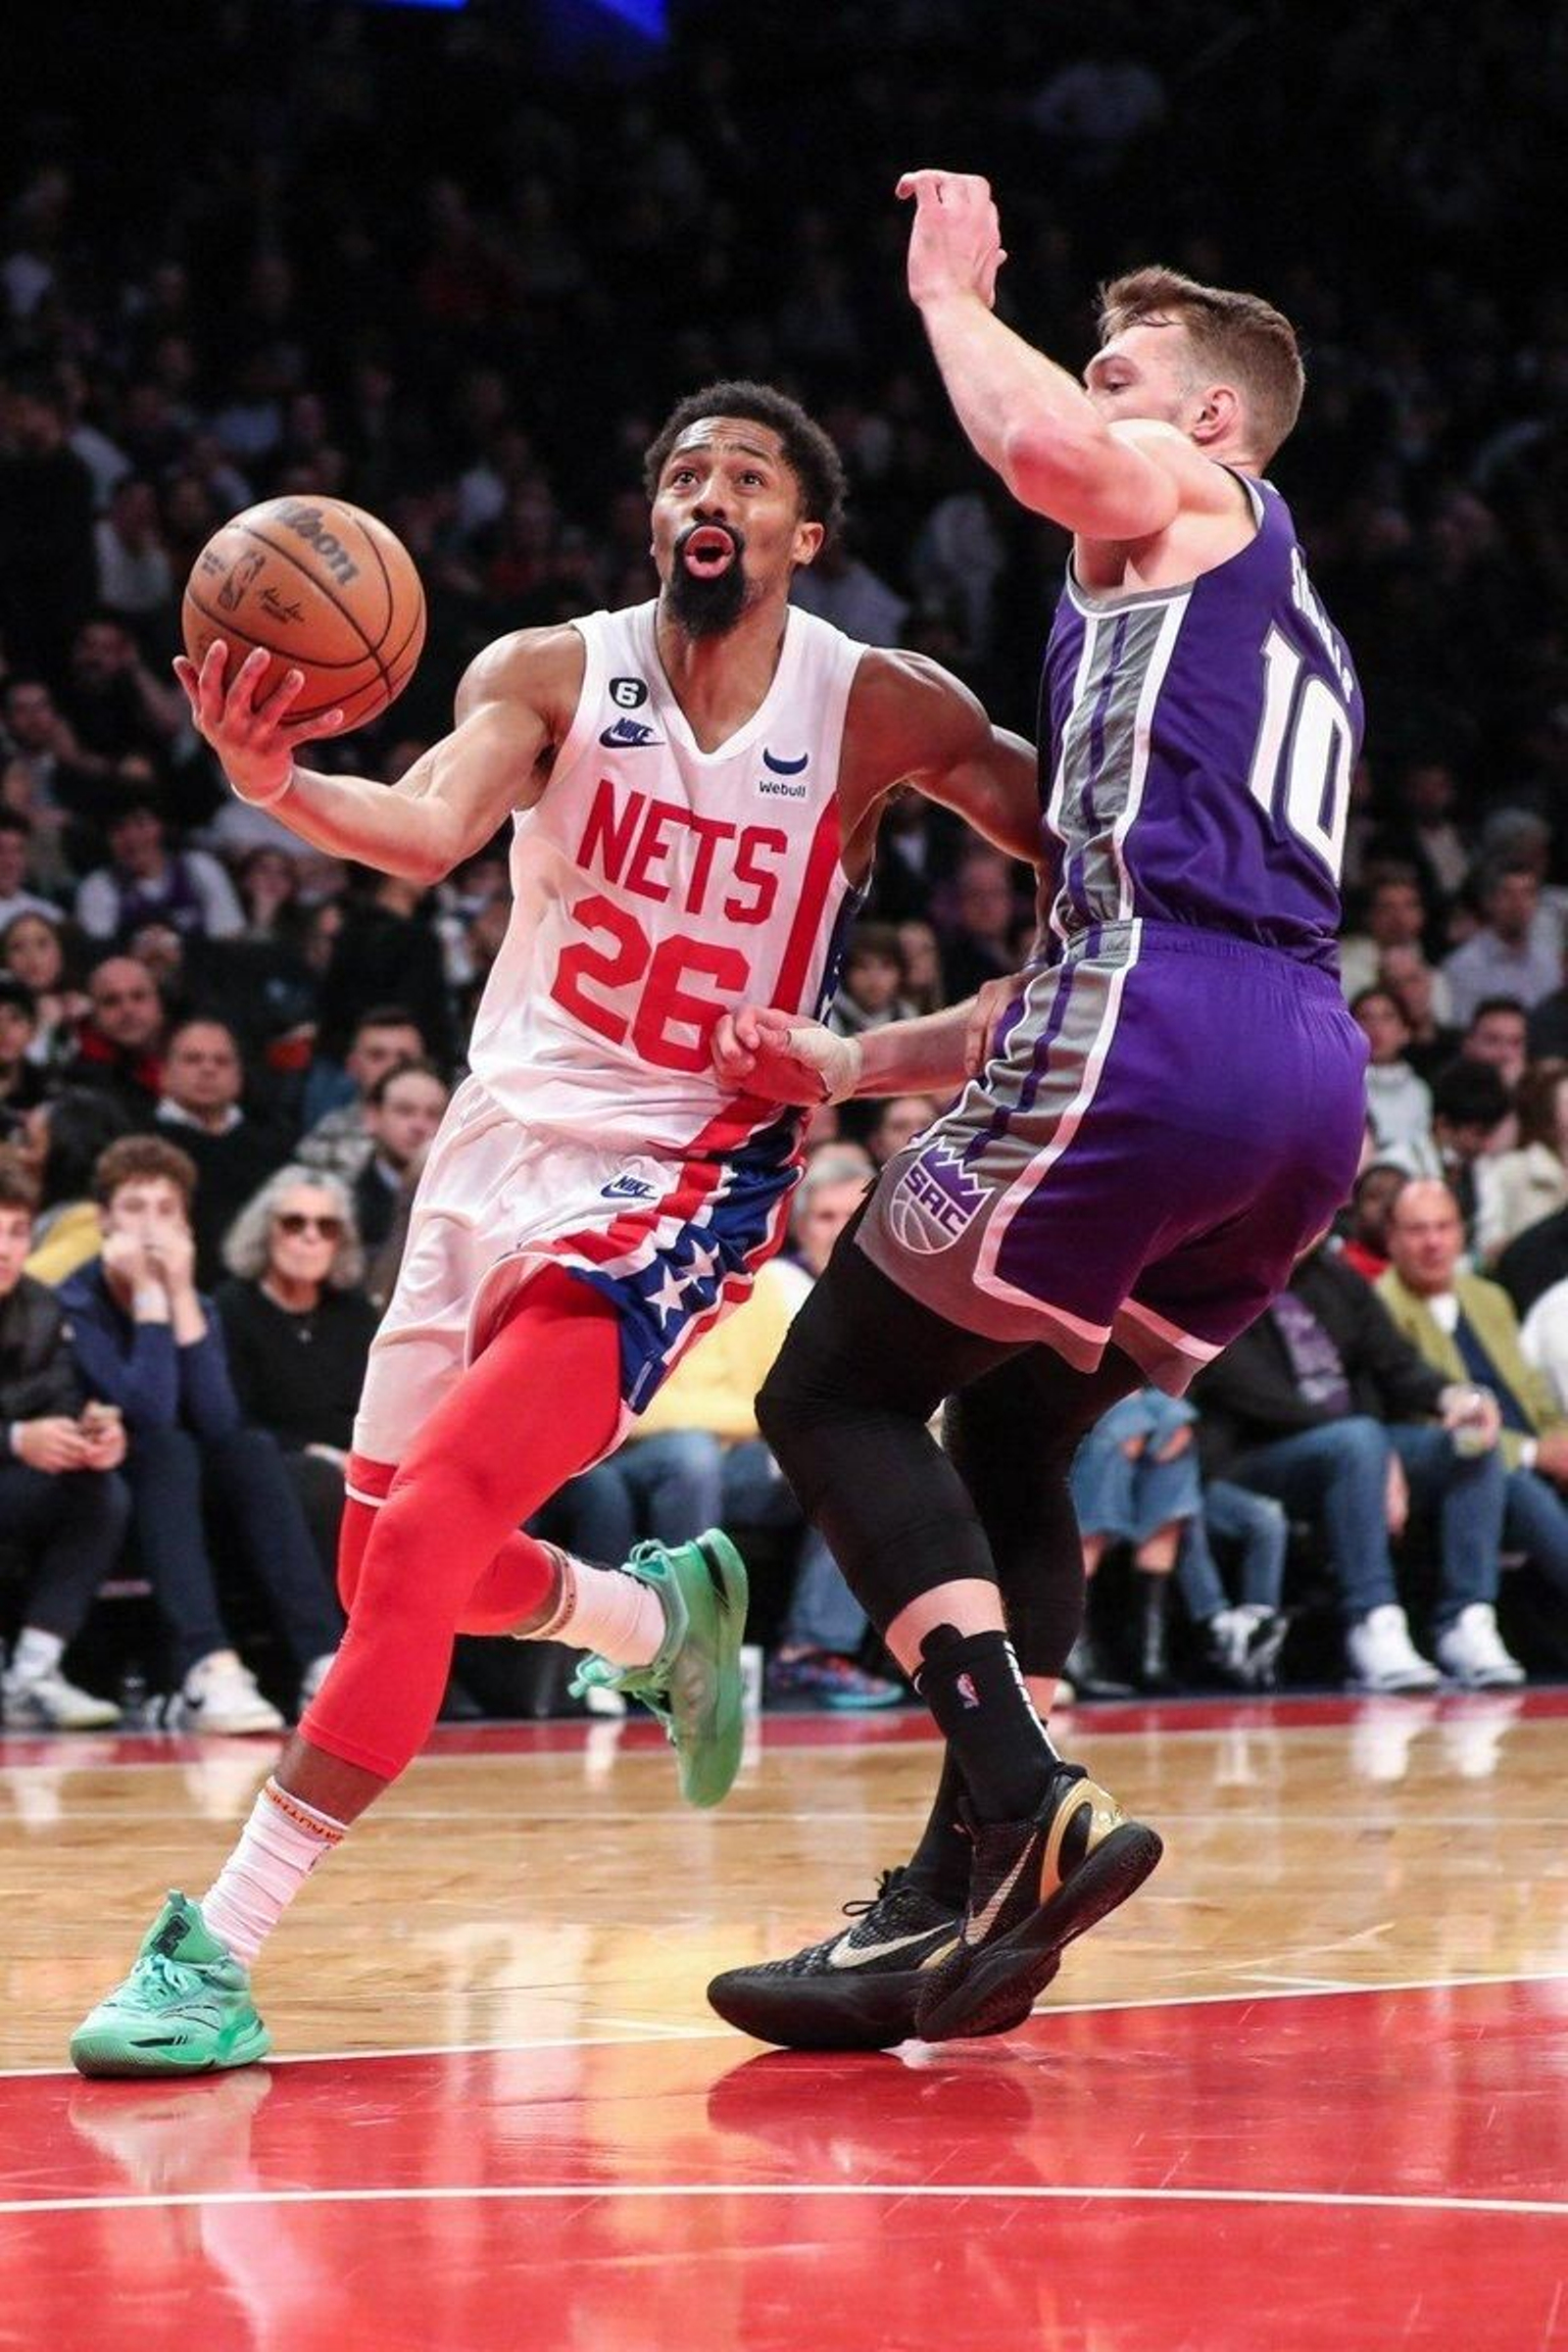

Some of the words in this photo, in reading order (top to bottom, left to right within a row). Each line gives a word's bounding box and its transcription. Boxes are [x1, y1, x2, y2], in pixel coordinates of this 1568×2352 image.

[616, 681, 639, 706] 6
[612, 717, 654, 744] NIKE
[1250, 621, 1352, 889] 10
[760, 781, 806, 797] Webull
[575, 778, 788, 925] NETS
[550, 895, 751, 1072] 26
[613, 1175, 655, 1197] NIKE
[903, 1163, 970, 1237] SAC
